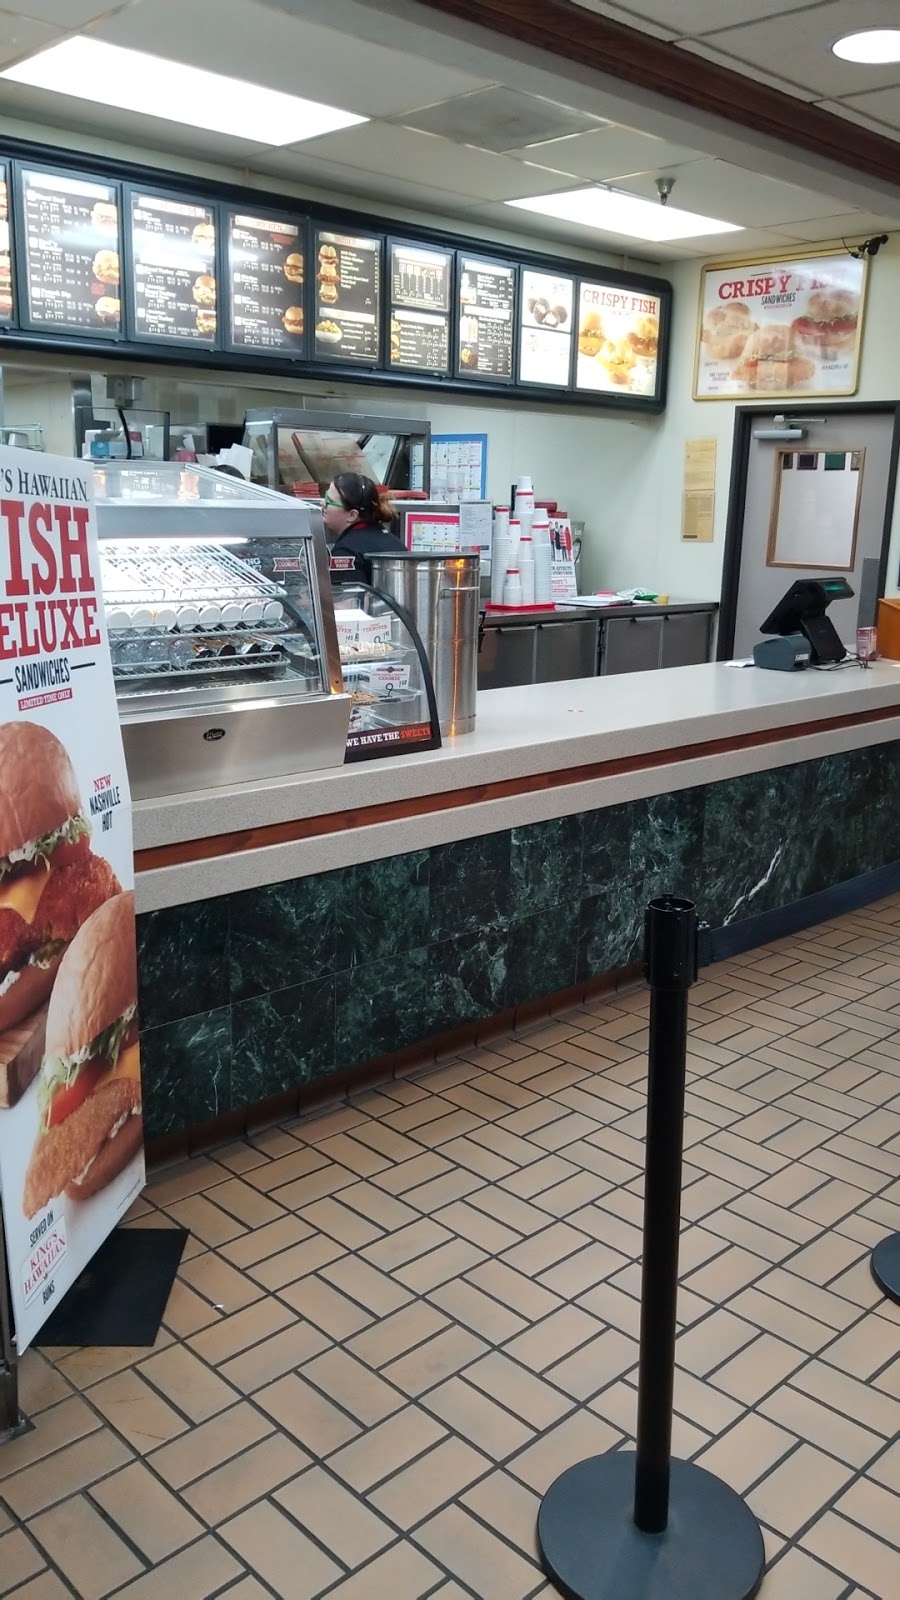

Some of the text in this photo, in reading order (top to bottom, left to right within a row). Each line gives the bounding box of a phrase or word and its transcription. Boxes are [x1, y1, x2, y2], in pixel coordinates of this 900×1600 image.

[583, 289, 628, 309] CRISPY
[631, 297, 656, 315] FISH
[719, 275, 792, 300] CRISPY
[761, 292, 796, 306] SANDWICHES
[17, 467, 88, 502] HAWAIIAN
[0, 499, 96, 597] ISH
[0, 597, 101, 660] ELUXE
[15, 657, 70, 693] SANDWICHES
[20, 690, 71, 710] LIMITED TIME ONLY
[346, 727, 431, 748] WE HAVE THE SWEETS
[93, 774, 111, 792] NEW
[89, 786, 121, 816] NASHVILLE
[102, 811, 113, 832] HOT
[30, 1209, 54, 1247] SERVED ON
[30, 1229, 58, 1271] KING'S
[24, 1237, 66, 1295] HAWAIIAN
